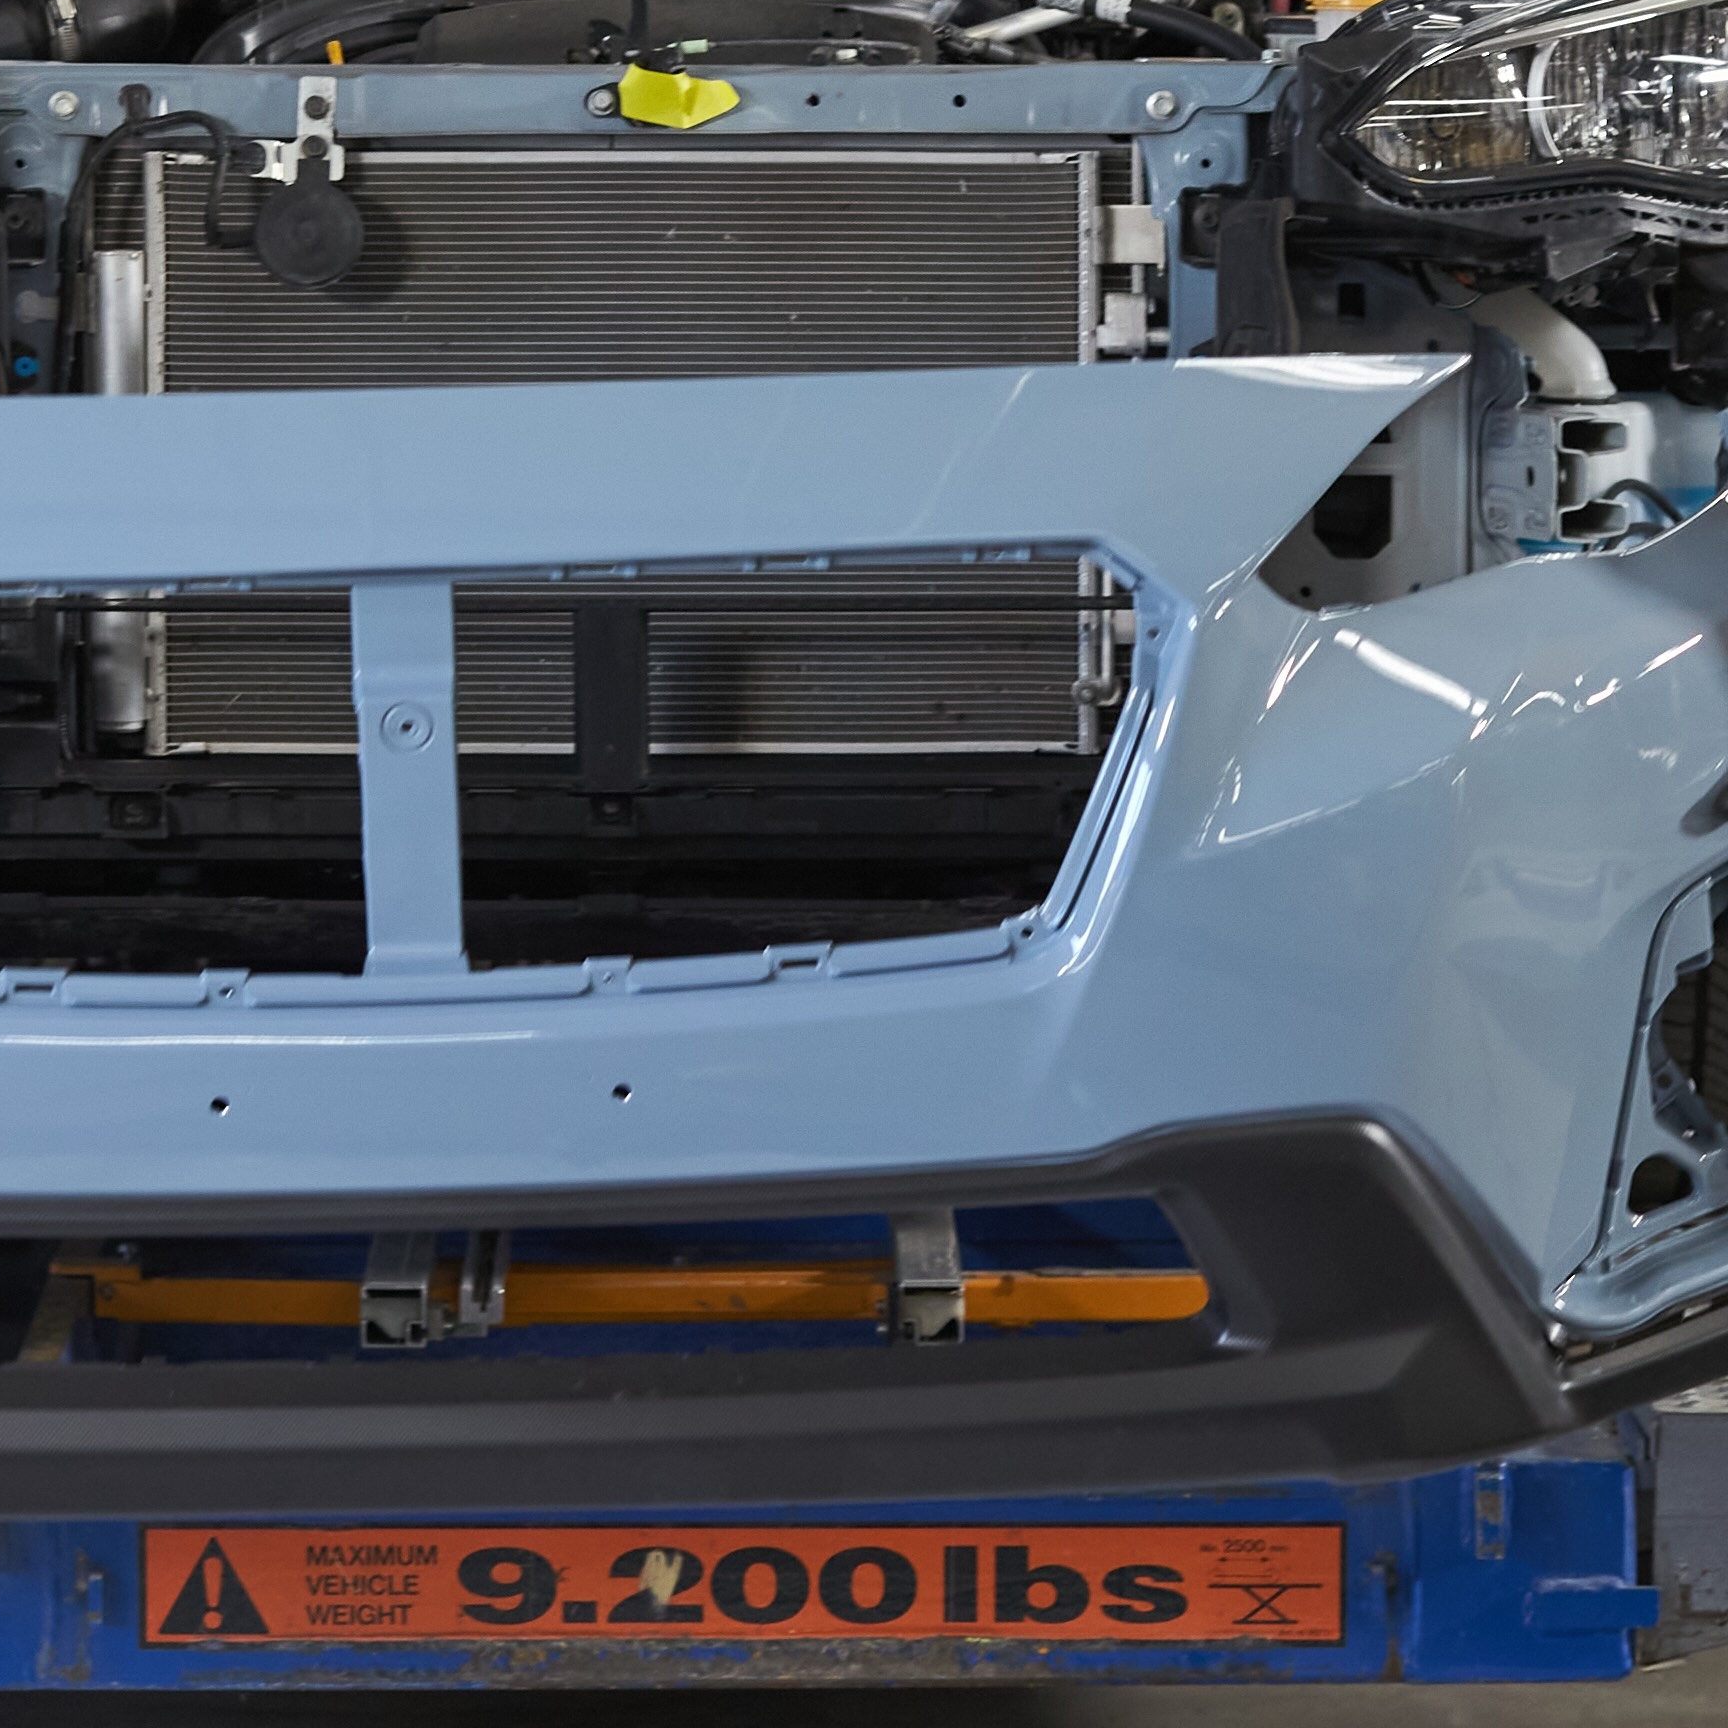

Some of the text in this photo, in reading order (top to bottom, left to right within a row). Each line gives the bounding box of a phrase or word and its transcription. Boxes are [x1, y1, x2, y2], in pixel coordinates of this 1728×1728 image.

[306, 1544, 438, 1566] MAXIMUM
[305, 1574, 420, 1596] VEHICLE
[457, 1544, 1189, 1624] 9.200 lbs
[305, 1604, 414, 1626] WEIGHT
